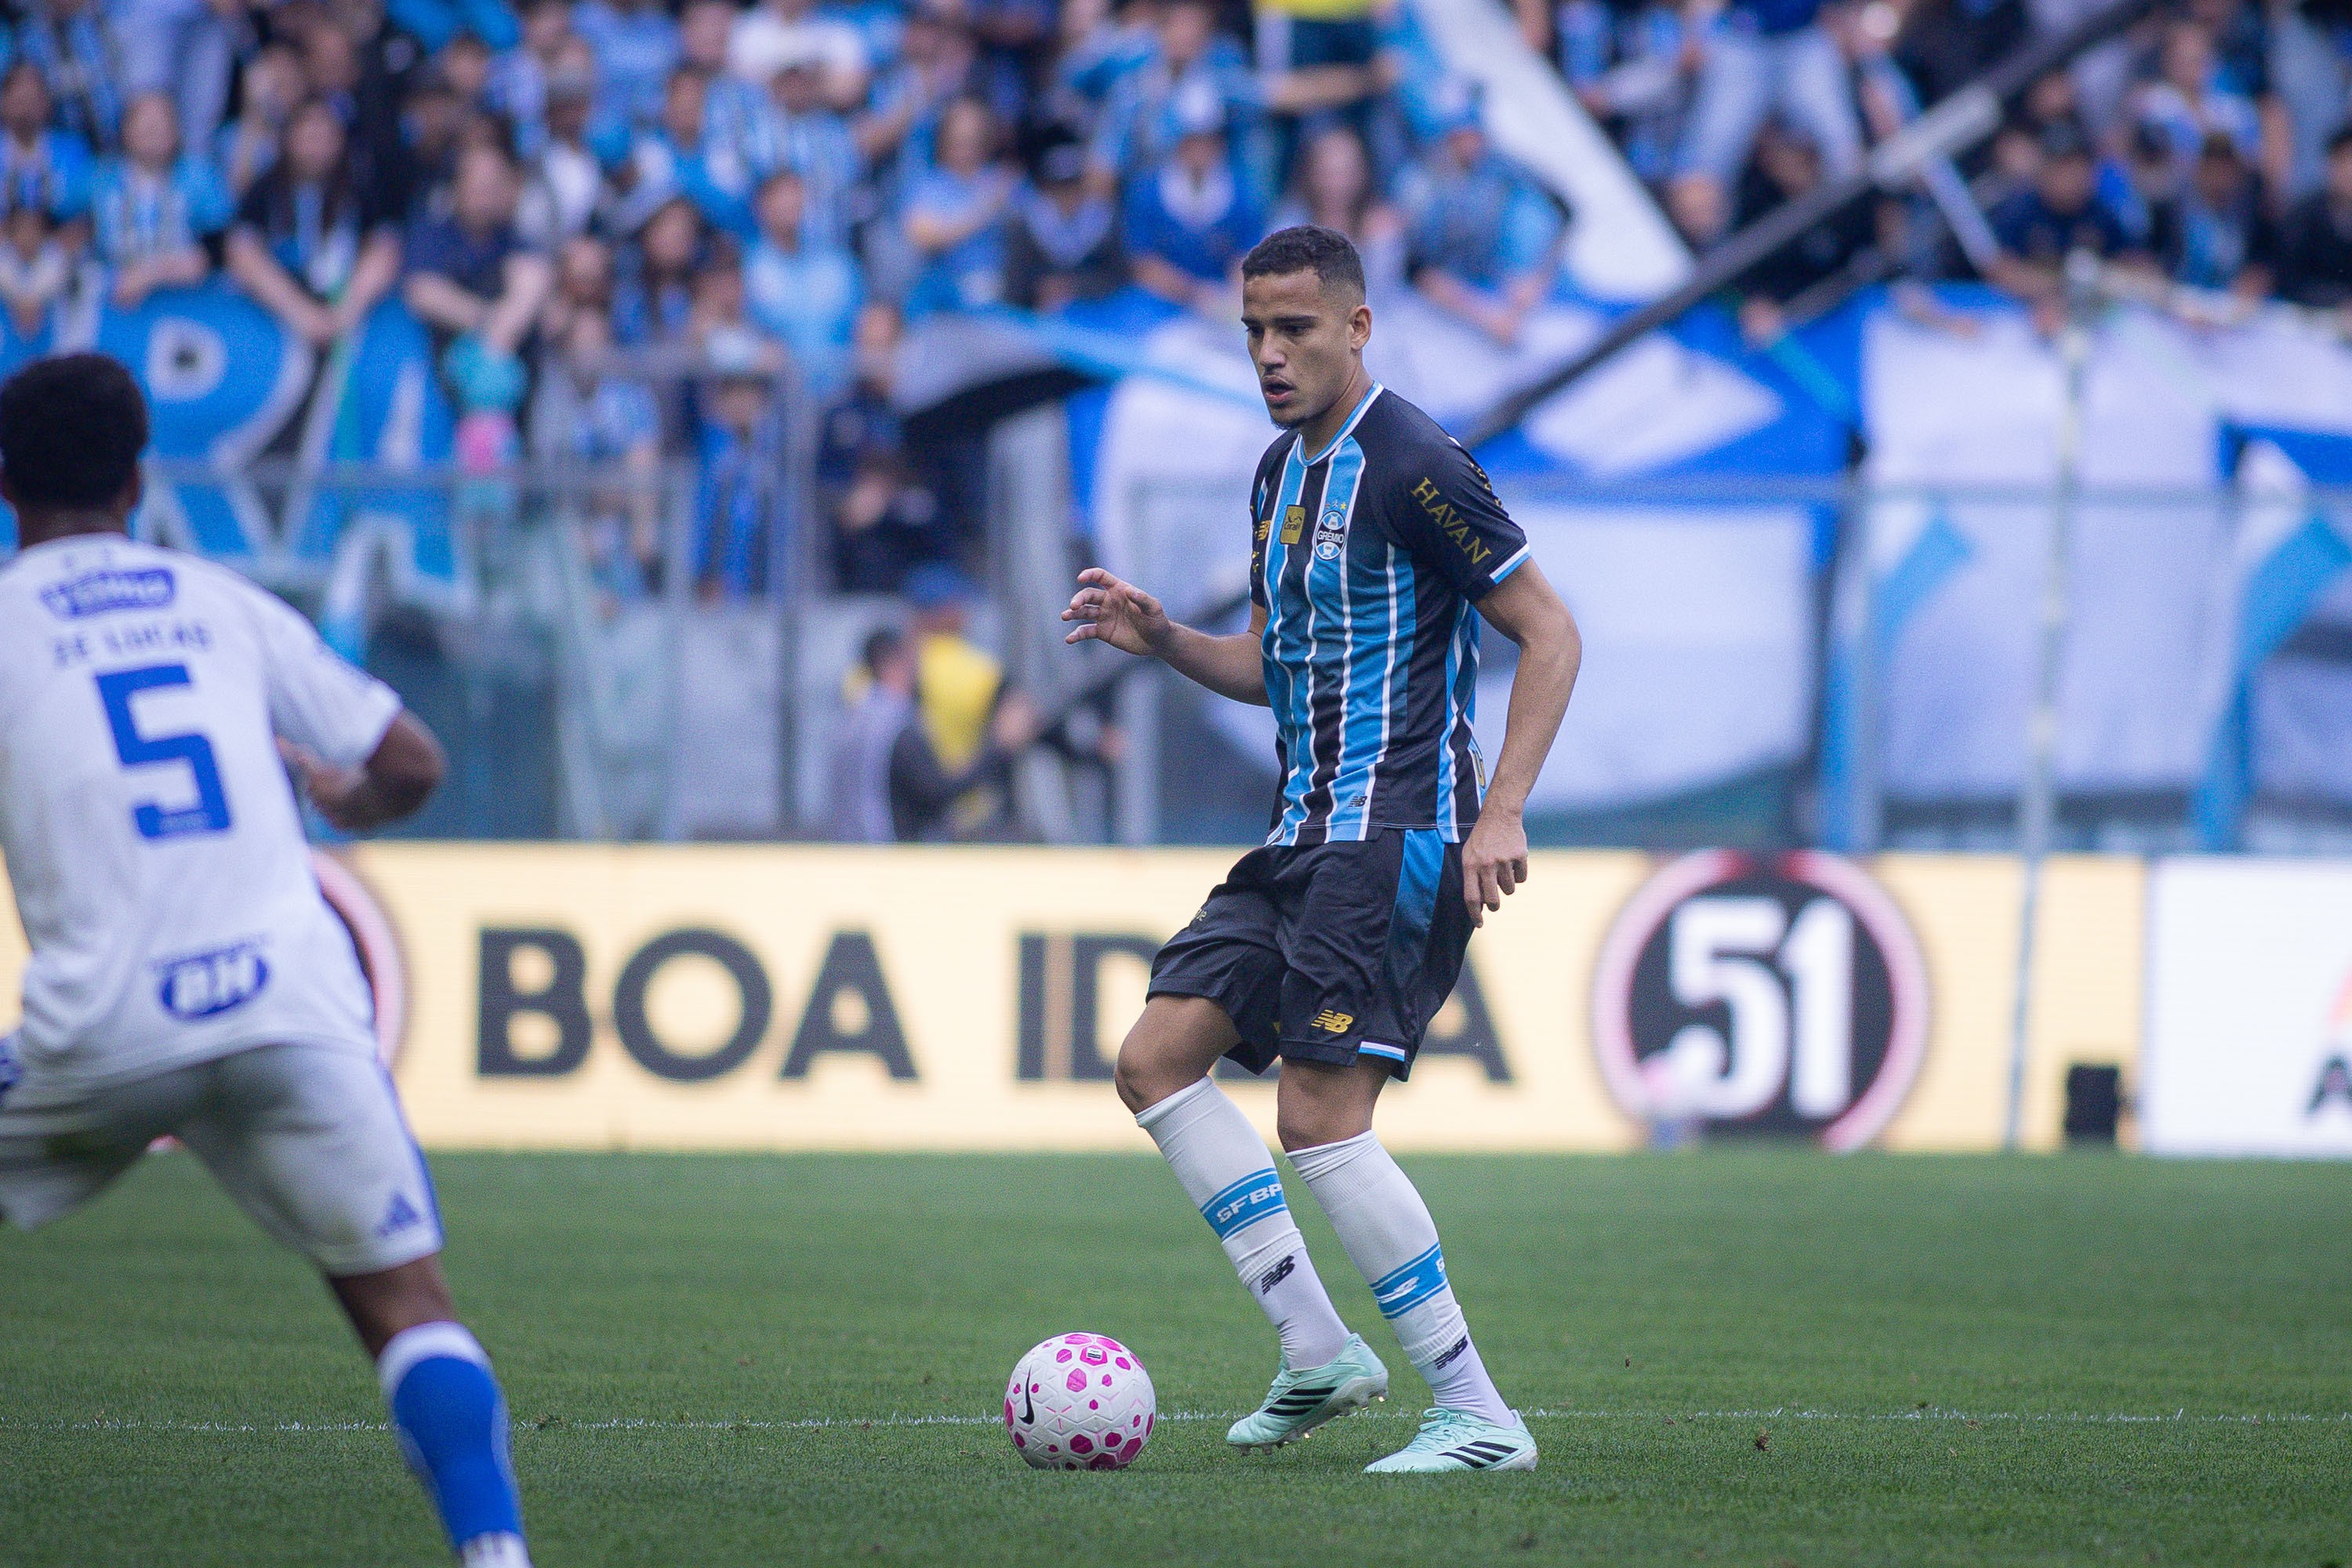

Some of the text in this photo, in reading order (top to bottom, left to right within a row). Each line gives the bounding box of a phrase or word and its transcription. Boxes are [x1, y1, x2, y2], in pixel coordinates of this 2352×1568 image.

[1410, 477, 1492, 564] HAVAN
[95, 658, 230, 840] 5
[477, 927, 921, 1083] BOA
[1644, 892, 1855, 1120] 51
